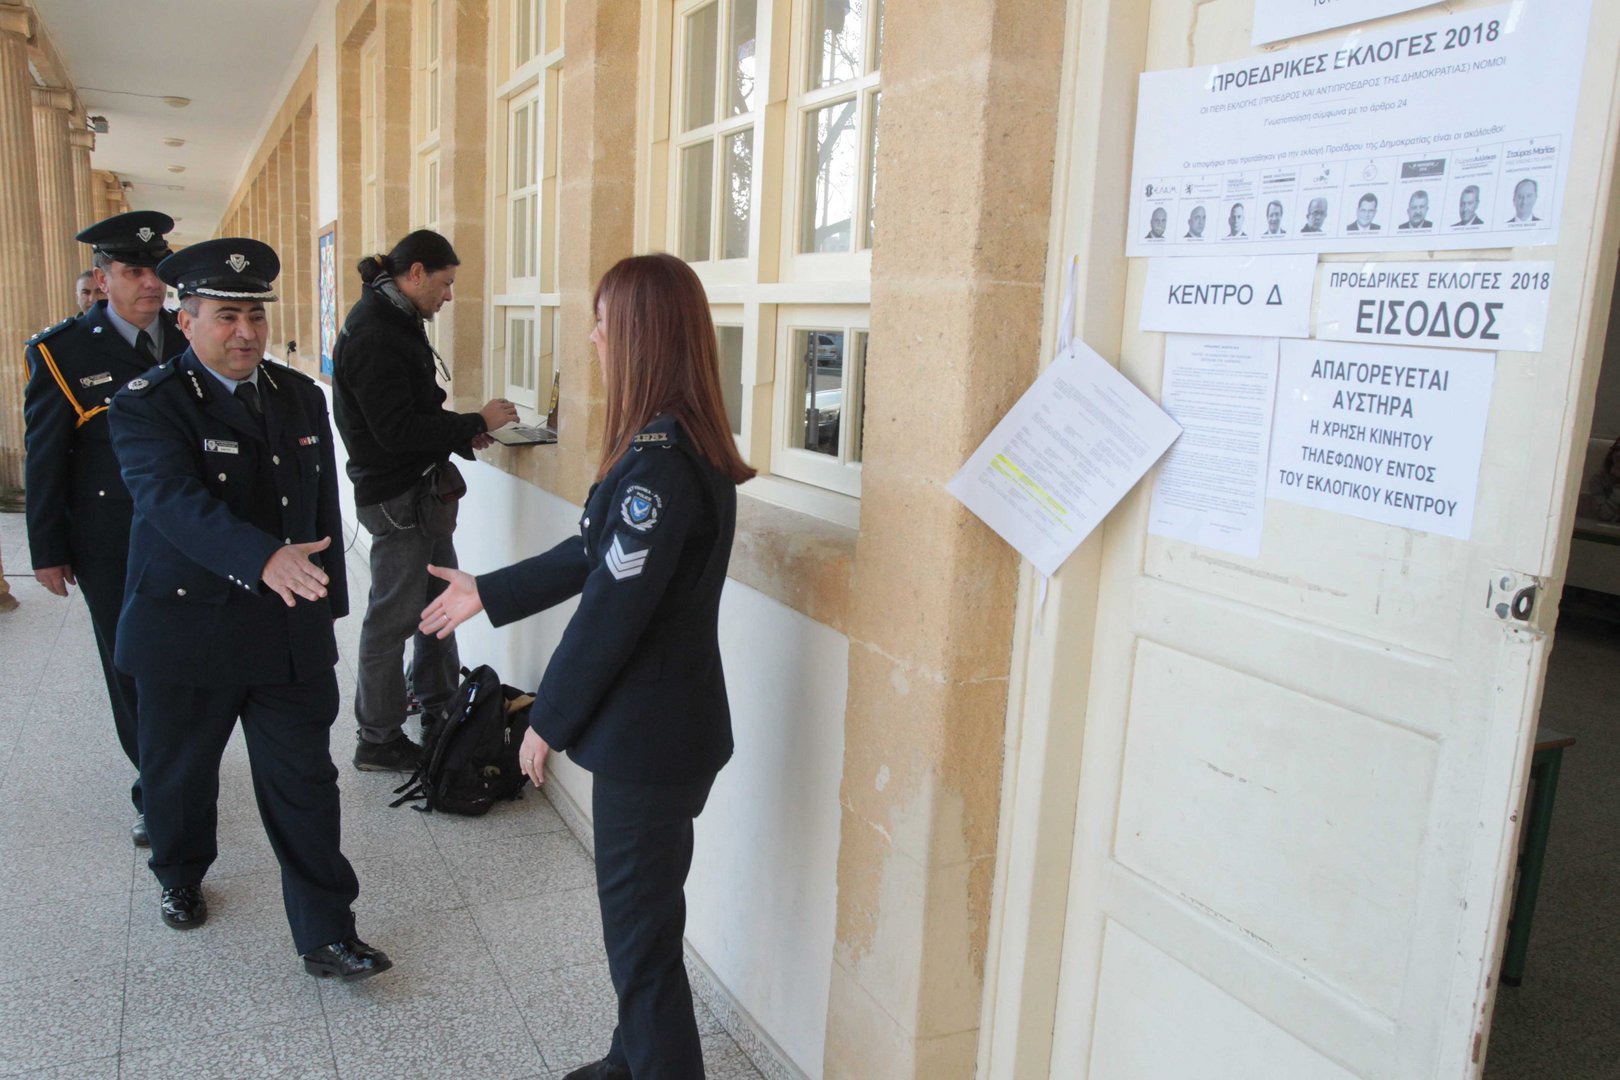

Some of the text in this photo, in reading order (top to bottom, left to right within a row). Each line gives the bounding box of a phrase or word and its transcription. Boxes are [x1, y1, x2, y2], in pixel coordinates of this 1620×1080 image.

[1211, 19, 1500, 93] ΠΡΟΕΔΡΙΚΕΣ ΕΚΛΟΓΕΣ 2018
[1210, 104, 1226, 113] ΠΕΡΙ
[1227, 98, 1258, 111] ΕΚΛΟΓΗΣ
[1302, 88, 1315, 97] ΚΑΙ
[1316, 77, 1381, 95] ΑΝΤΙΠΡΟΕΔΡΟΣ
[1383, 74, 1401, 85] ΤΗΣ
[1401, 62, 1471, 83] ΔΗΜΟΚΡΑΤΙΑΣ)
[1472, 56, 1507, 70] ΝΟΜΟΙ
[1348, 106, 1358, 115] με
[1369, 101, 1395, 113] άρθρο
[1397, 99, 1407, 108] 24
[1168, 284, 1283, 305] ΚΕΝΤΡΟ Δ
[1330, 272, 1550, 290] ΠΡΟΕΔΡΙΚΕΣ ΕΚΛΟΓΕΣ 2018
[1356, 299, 1504, 340] ΕΙΣΟΔΟΣ
[1311, 359, 1449, 392] ΑΠΑΓΟΡΕΥΕΤΑΙ
[1332, 390, 1414, 419] ΑΥΣΤΗΡΑ
[1310, 419, 1433, 451] Η ΧΡΗΣΗ ΚΙΝΗΤΟΥ
[1301, 445, 1436, 483] ΤΗΛΕΦΩΝΟΥ ΕΝΤΟΣ
[1279, 469, 1458, 517] ΤΟΥ ΕΚΛΟΓΙΚΟΥ ΚΕΝΤΡΟΥ
